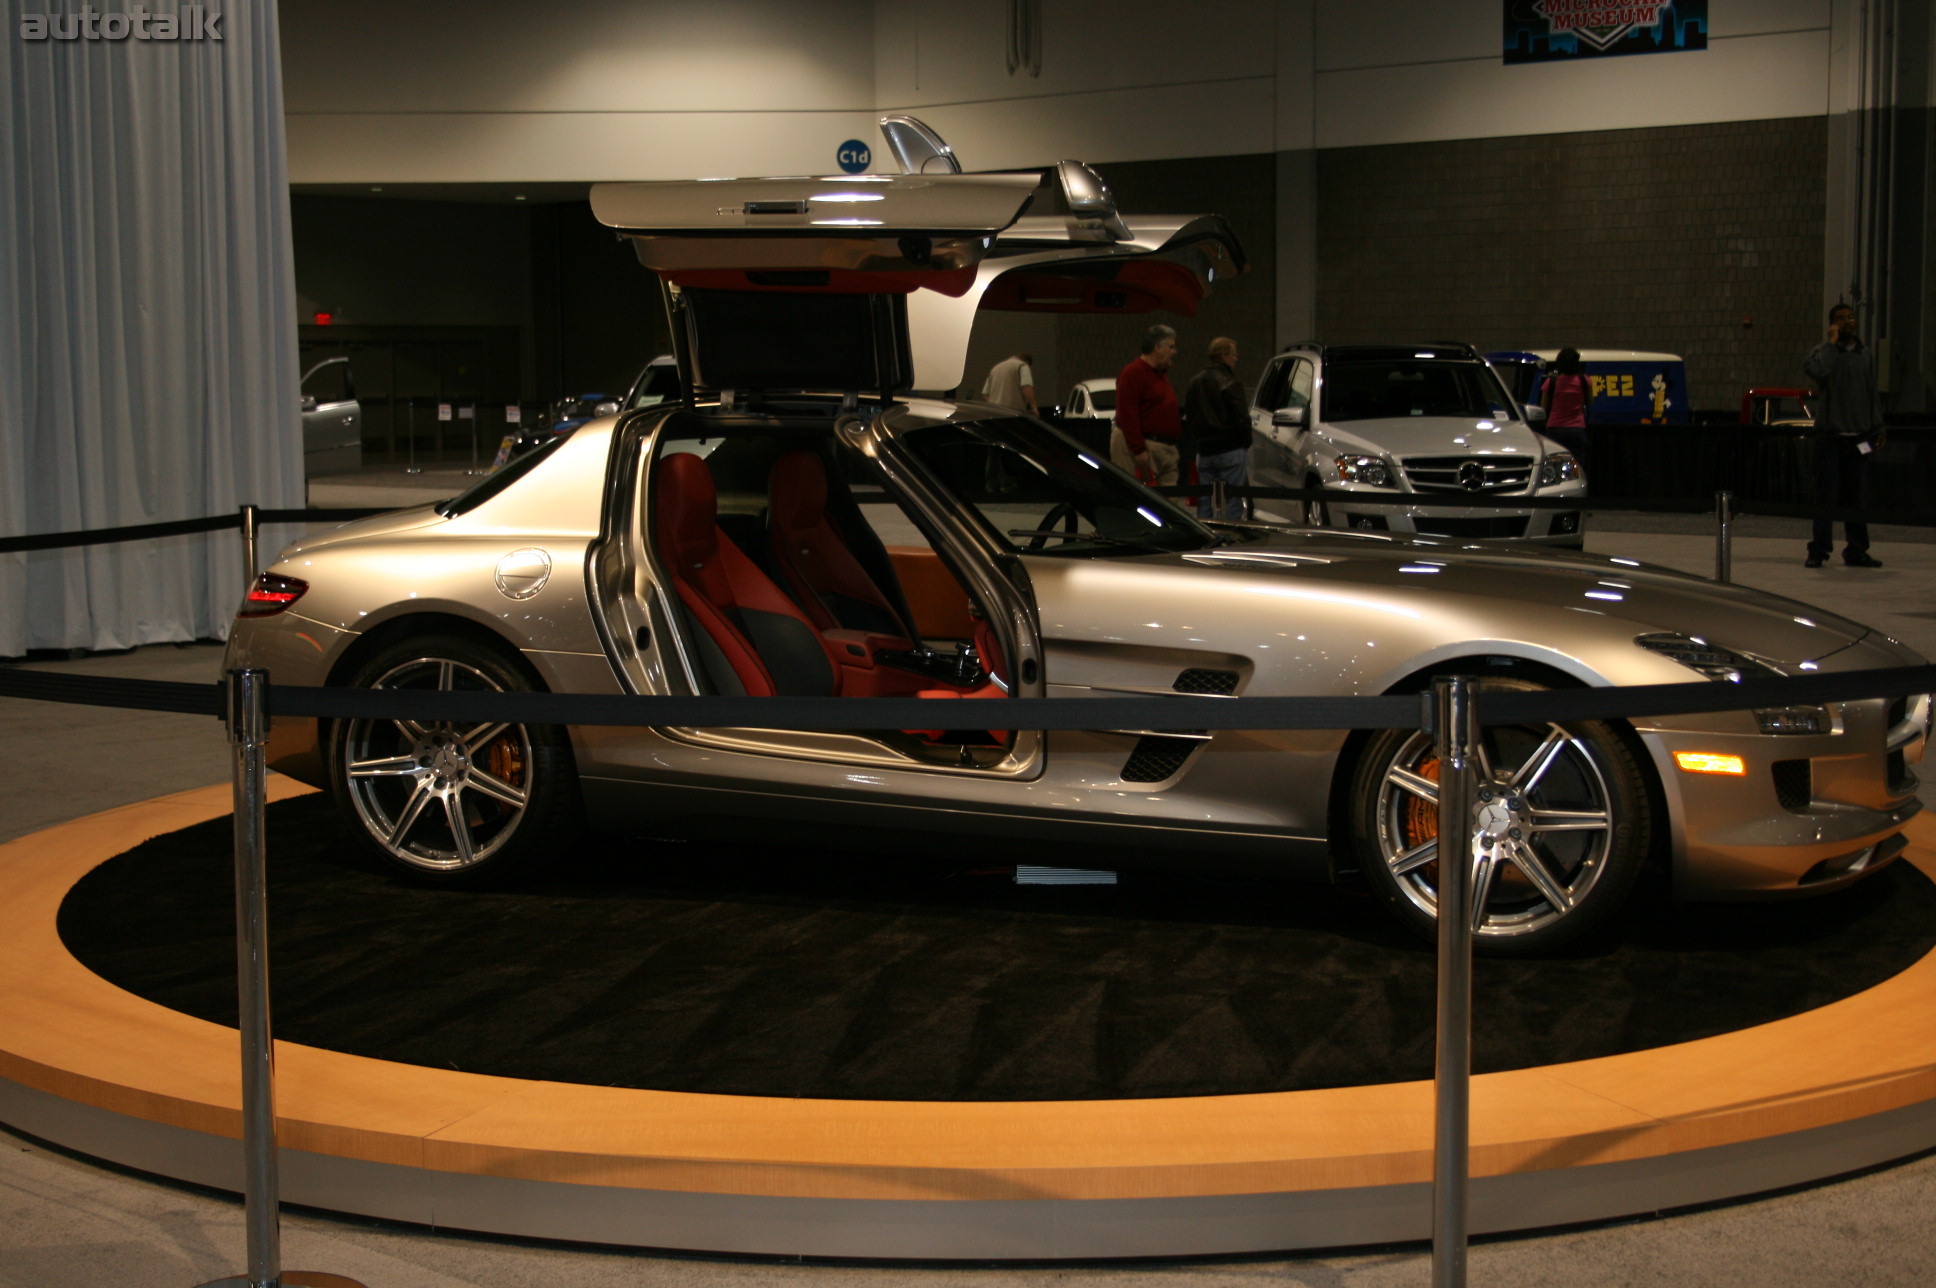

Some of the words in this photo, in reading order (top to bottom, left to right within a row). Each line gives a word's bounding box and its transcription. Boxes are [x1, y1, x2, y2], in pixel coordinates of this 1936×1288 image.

[1543, 0, 1666, 13] MICRO
[1554, 7, 1655, 30] MUSEUM
[840, 150, 868, 164] C1d
[1590, 375, 1634, 397] PEZ
